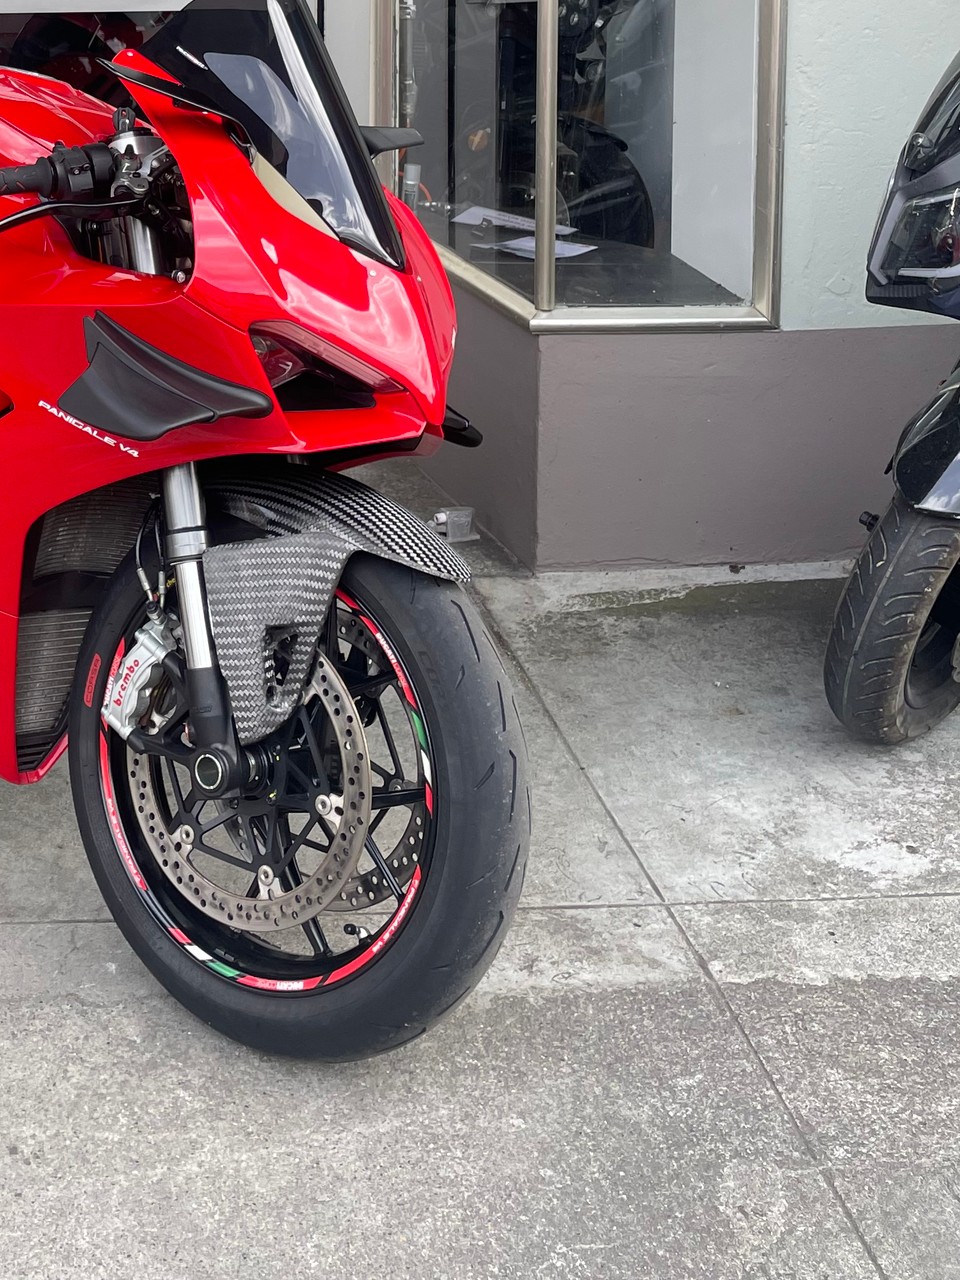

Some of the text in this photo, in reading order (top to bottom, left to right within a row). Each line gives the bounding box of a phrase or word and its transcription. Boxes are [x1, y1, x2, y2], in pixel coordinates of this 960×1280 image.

[38, 400, 139, 458] PANIGALE V4
[375, 631, 398, 663] DUCATI
[113, 659, 139, 706] brembo
